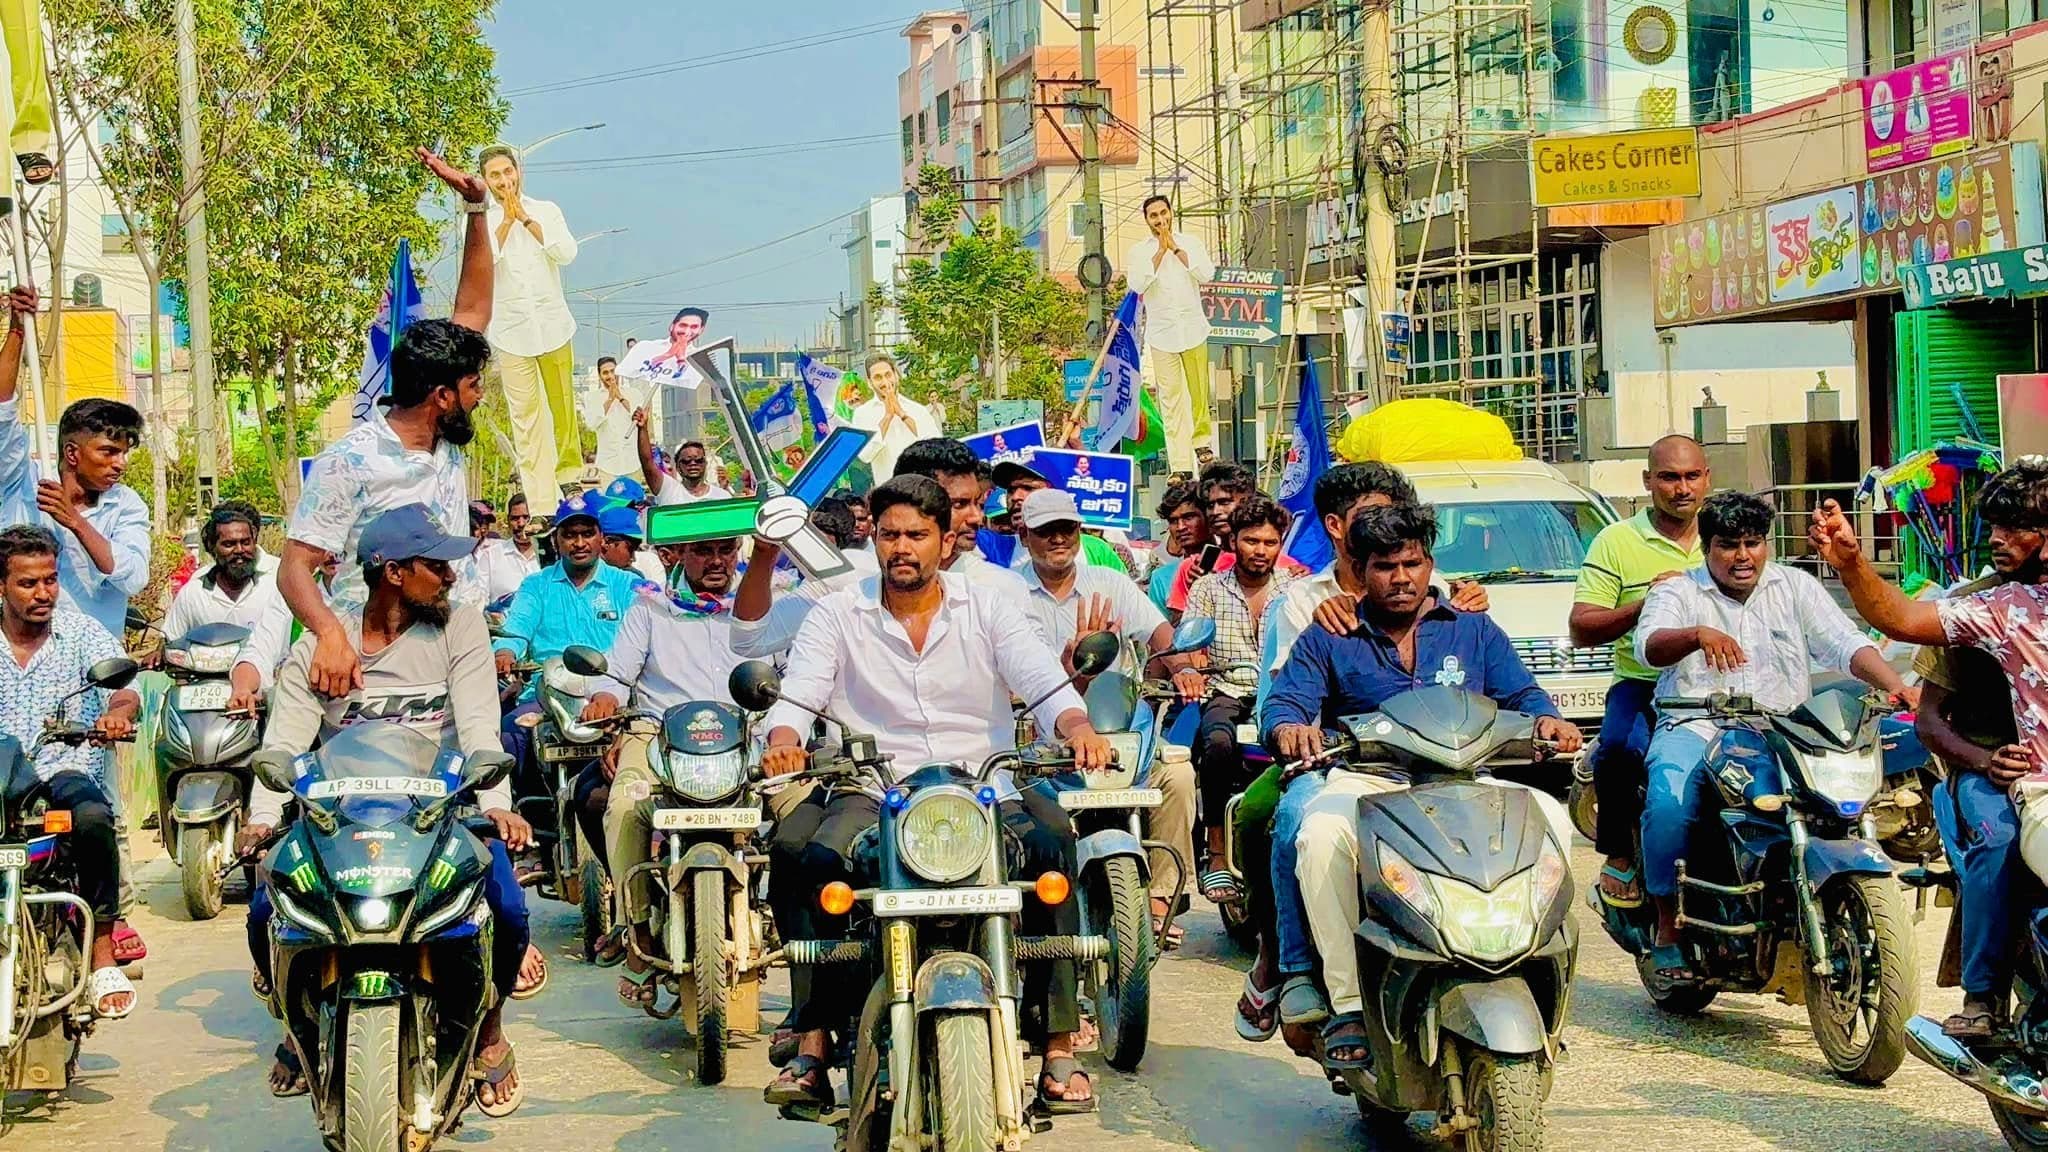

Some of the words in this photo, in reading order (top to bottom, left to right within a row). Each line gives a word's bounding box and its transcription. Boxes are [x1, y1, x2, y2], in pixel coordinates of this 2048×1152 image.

[1538, 144, 1606, 174] Cakes
[1612, 142, 1693, 169] Corner
[1562, 181, 1604, 197] Cakes
[1608, 180, 1617, 194] &
[1622, 176, 1672, 194] Snacks
[1220, 270, 1273, 284] STRONG
[1926, 258, 2005, 296] Raju
[2024, 247, 2048, 282] S
[1217, 287, 1244, 295] FITNESS
[1246, 288, 1276, 297] FACTORY
[1201, 296, 1264, 322] GYM
[1066, 474, 1127, 496] నమ్మకం
[1081, 497, 1123, 514] జగన్
[343, 692, 448, 721] KTM
[557, 747, 569, 757] AP
[328, 781, 347, 793] AP
[354, 779, 393, 791] 39LL
[403, 779, 443, 793] 7336
[664, 815, 677, 826] AP
[692, 814, 705, 825] 26
[708, 814, 721, 825] BN
[732, 813, 756, 824] 7489
